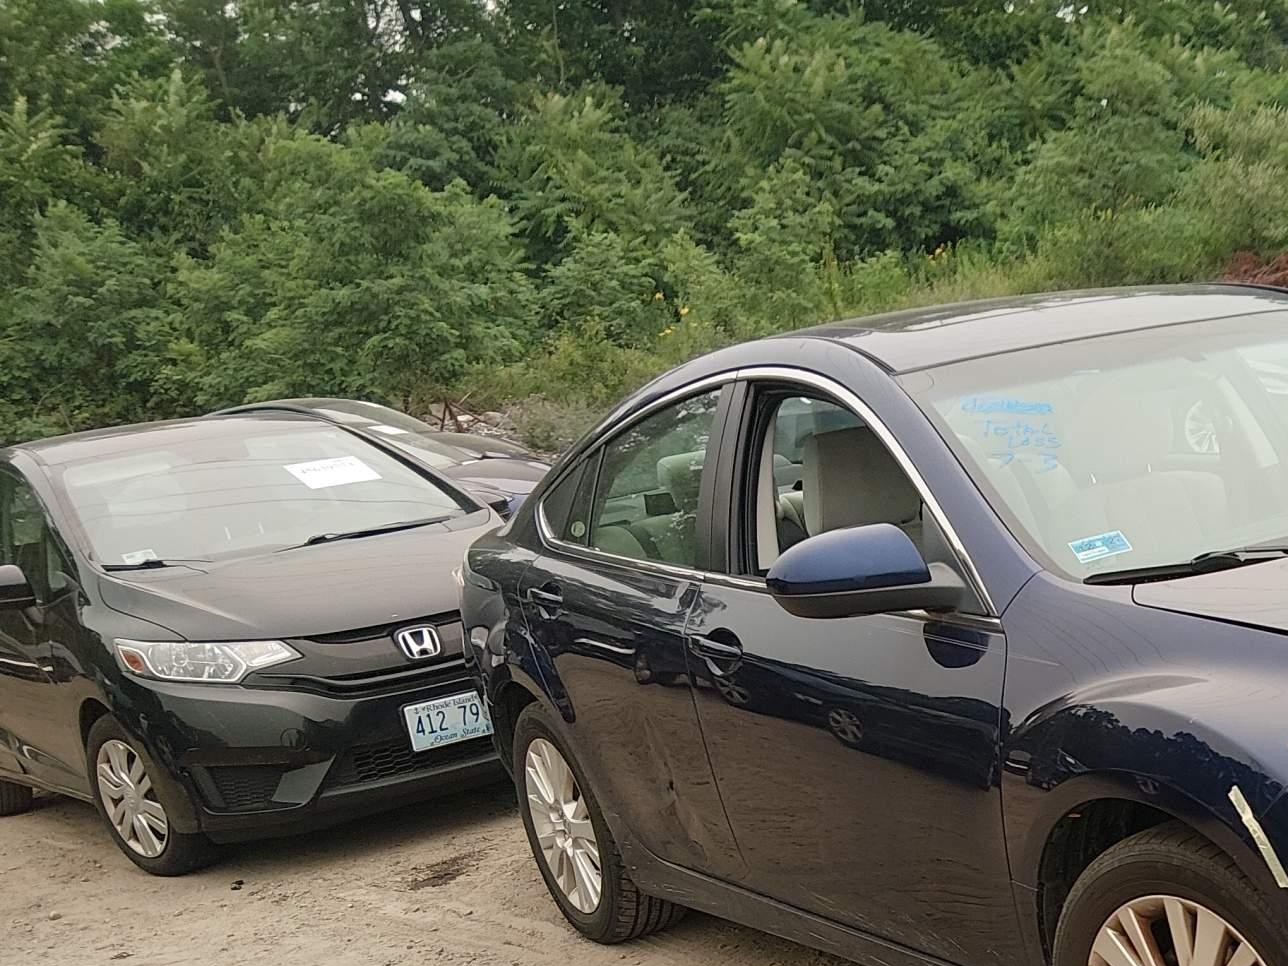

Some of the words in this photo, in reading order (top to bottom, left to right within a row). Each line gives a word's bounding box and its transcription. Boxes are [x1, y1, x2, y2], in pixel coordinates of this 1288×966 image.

[425, 701, 451, 713] Rhode
[453, 694, 475, 707] Island
[416, 711, 449, 737] 412
[457, 703, 480, 726] 79
[434, 732, 458, 743] Ocean
[462, 726, 480, 737] State
